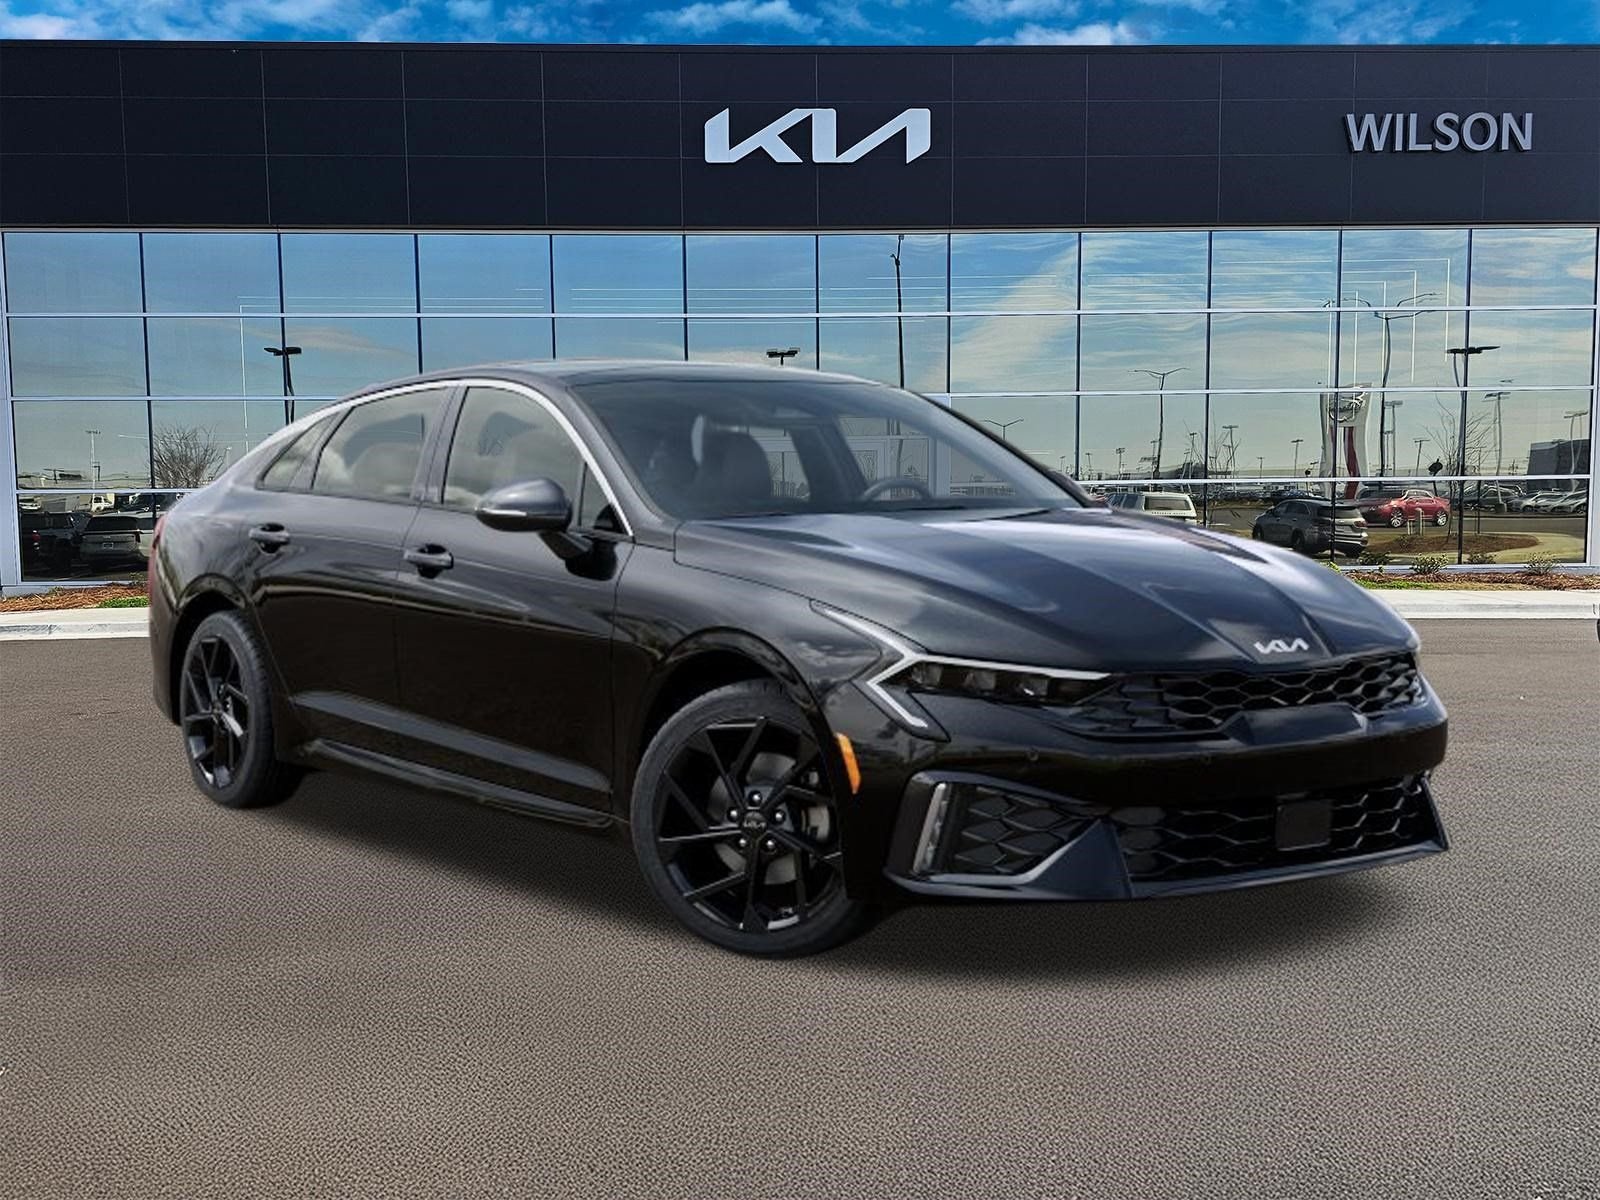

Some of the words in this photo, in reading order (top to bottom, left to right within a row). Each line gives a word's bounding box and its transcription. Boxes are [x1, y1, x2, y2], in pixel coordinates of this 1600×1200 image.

[704, 107, 931, 164] KIA
[1345, 112, 1533, 152] WILSON
[1253, 638, 1309, 655] KIA
